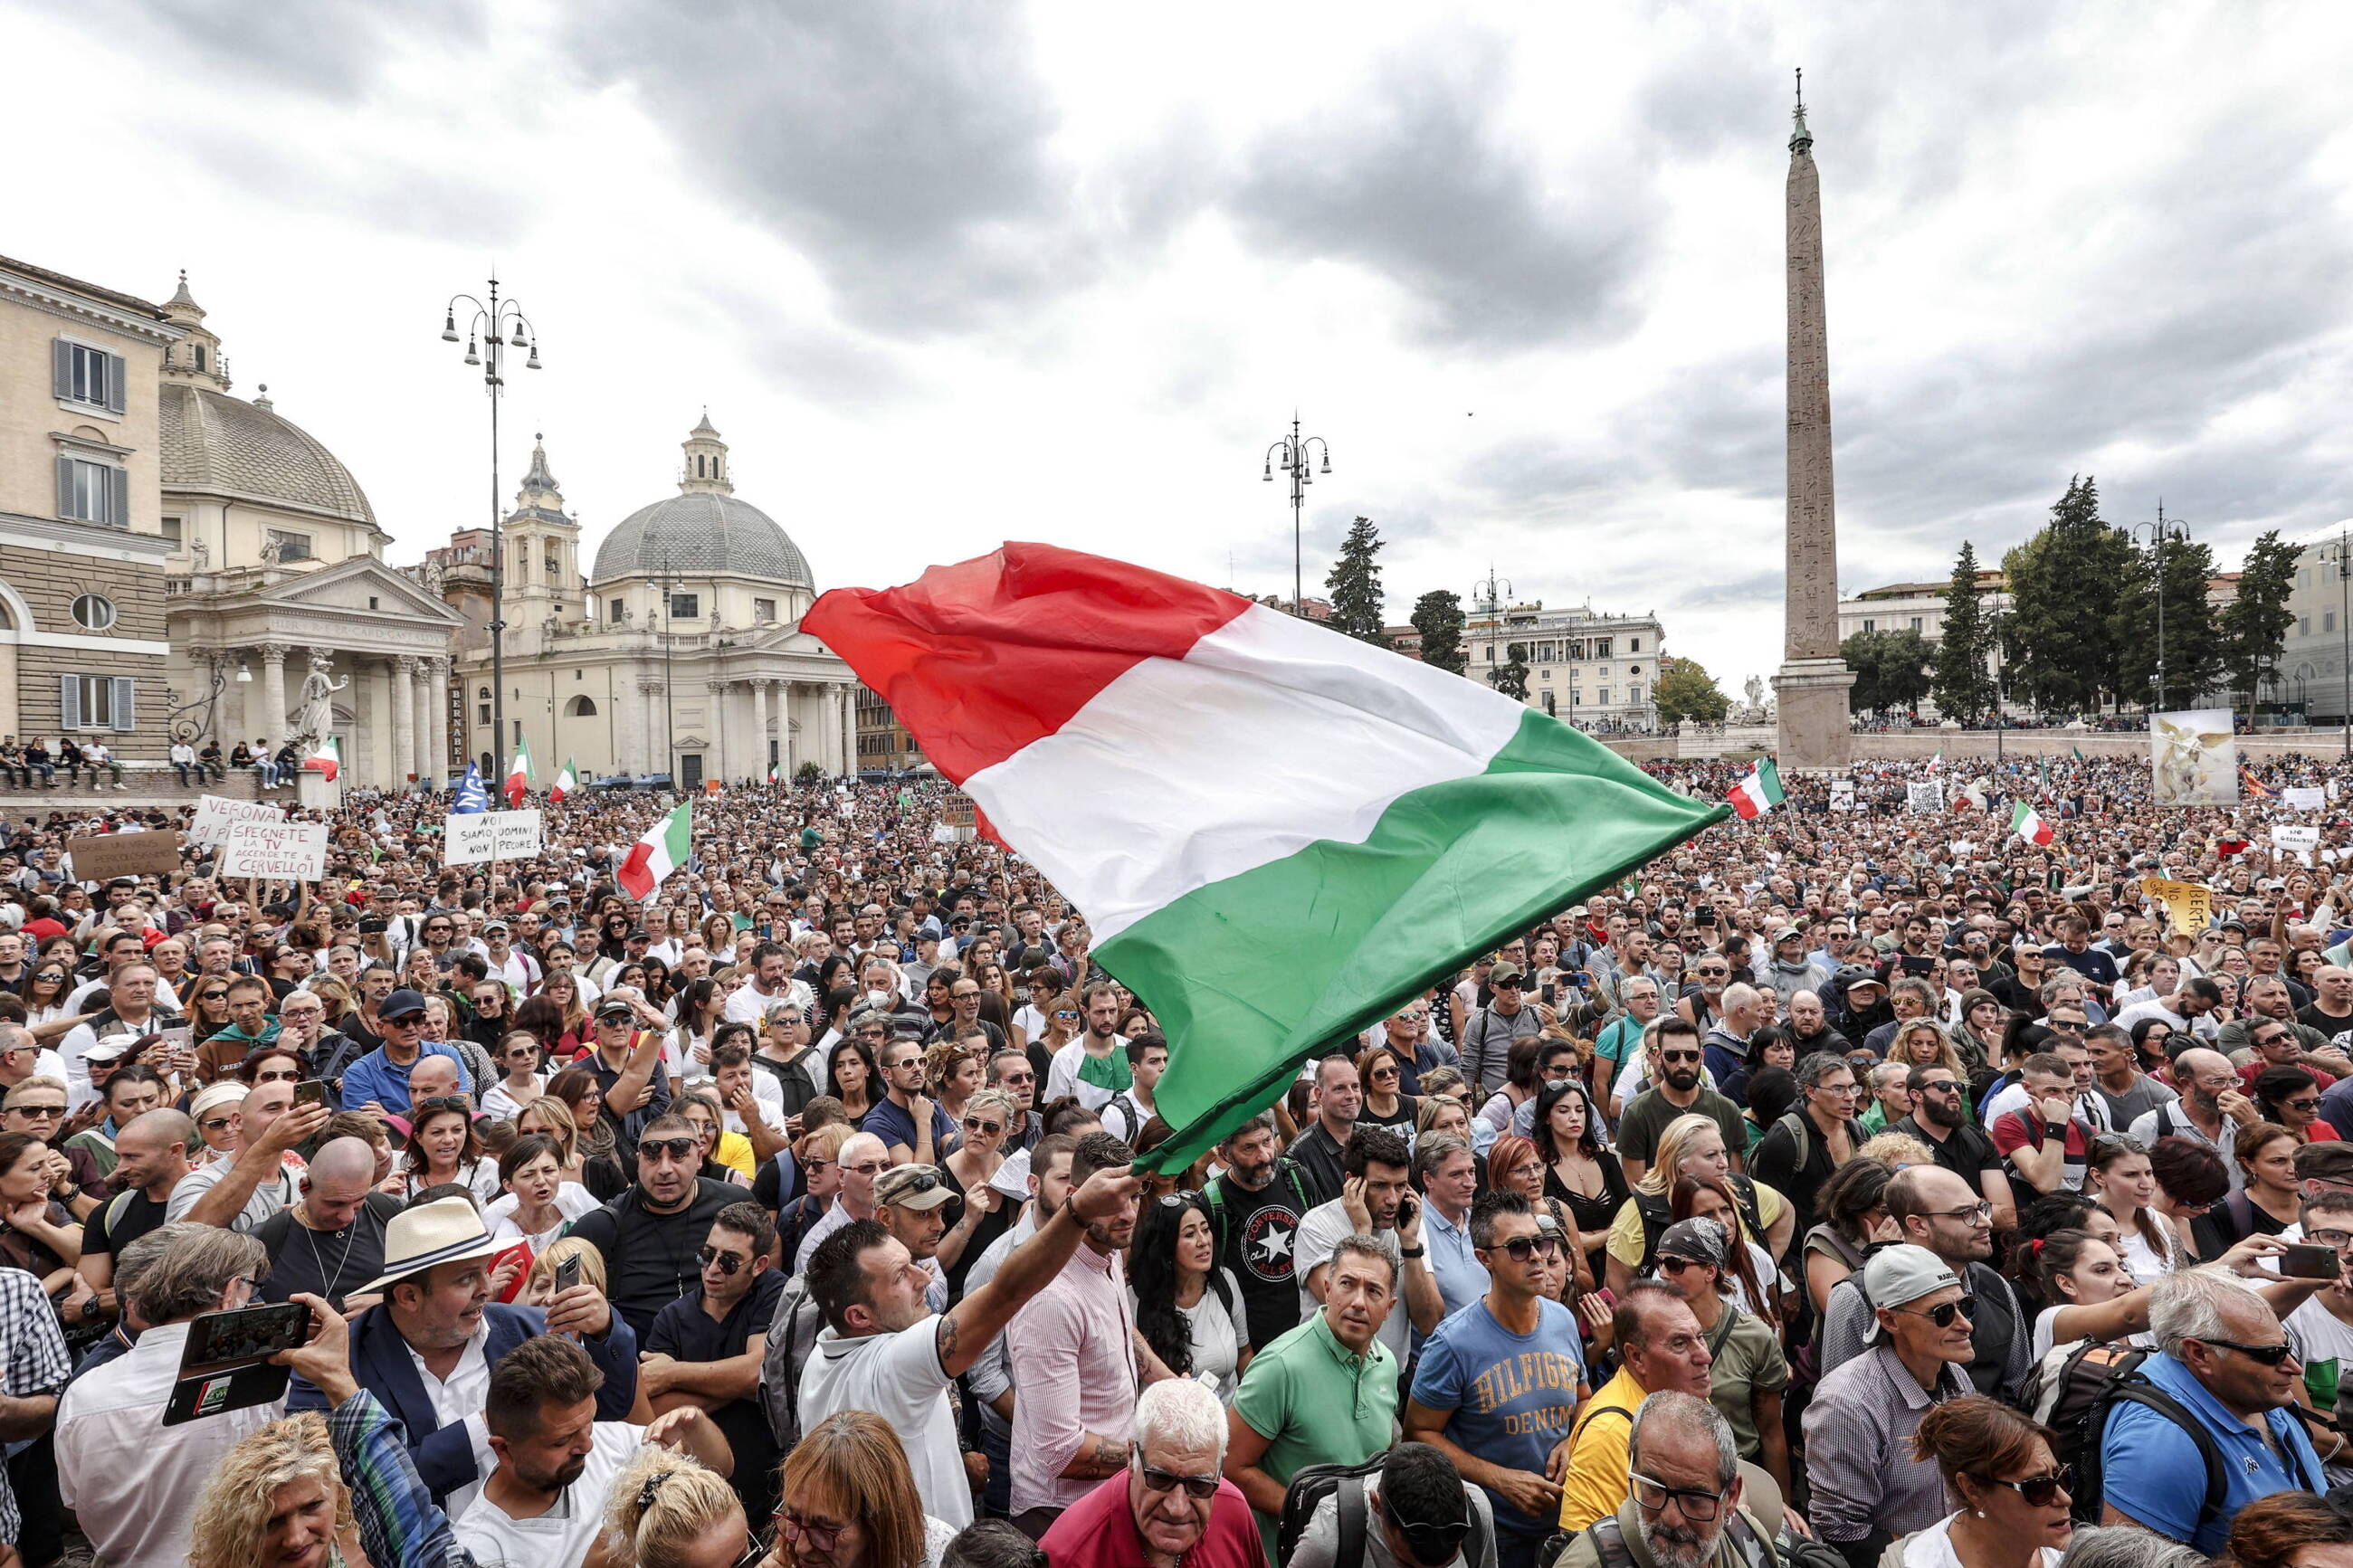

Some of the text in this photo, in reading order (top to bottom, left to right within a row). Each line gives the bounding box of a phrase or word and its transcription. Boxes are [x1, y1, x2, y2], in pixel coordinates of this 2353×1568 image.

[452, 689, 462, 765] BERNABEI
[209, 799, 277, 822] VERONA
[481, 816, 501, 826] NOI
[233, 825, 309, 842] SPEGNETE
[461, 829, 492, 841] SIAMO
[243, 840, 281, 850] LA TV
[469, 844, 490, 854] NON
[239, 859, 314, 877] CERVELLO!
[2168, 887, 2181, 901] NO
[1248, 1211, 1296, 1241] CONVERSE
[1259, 1263, 1276, 1276] ALL
